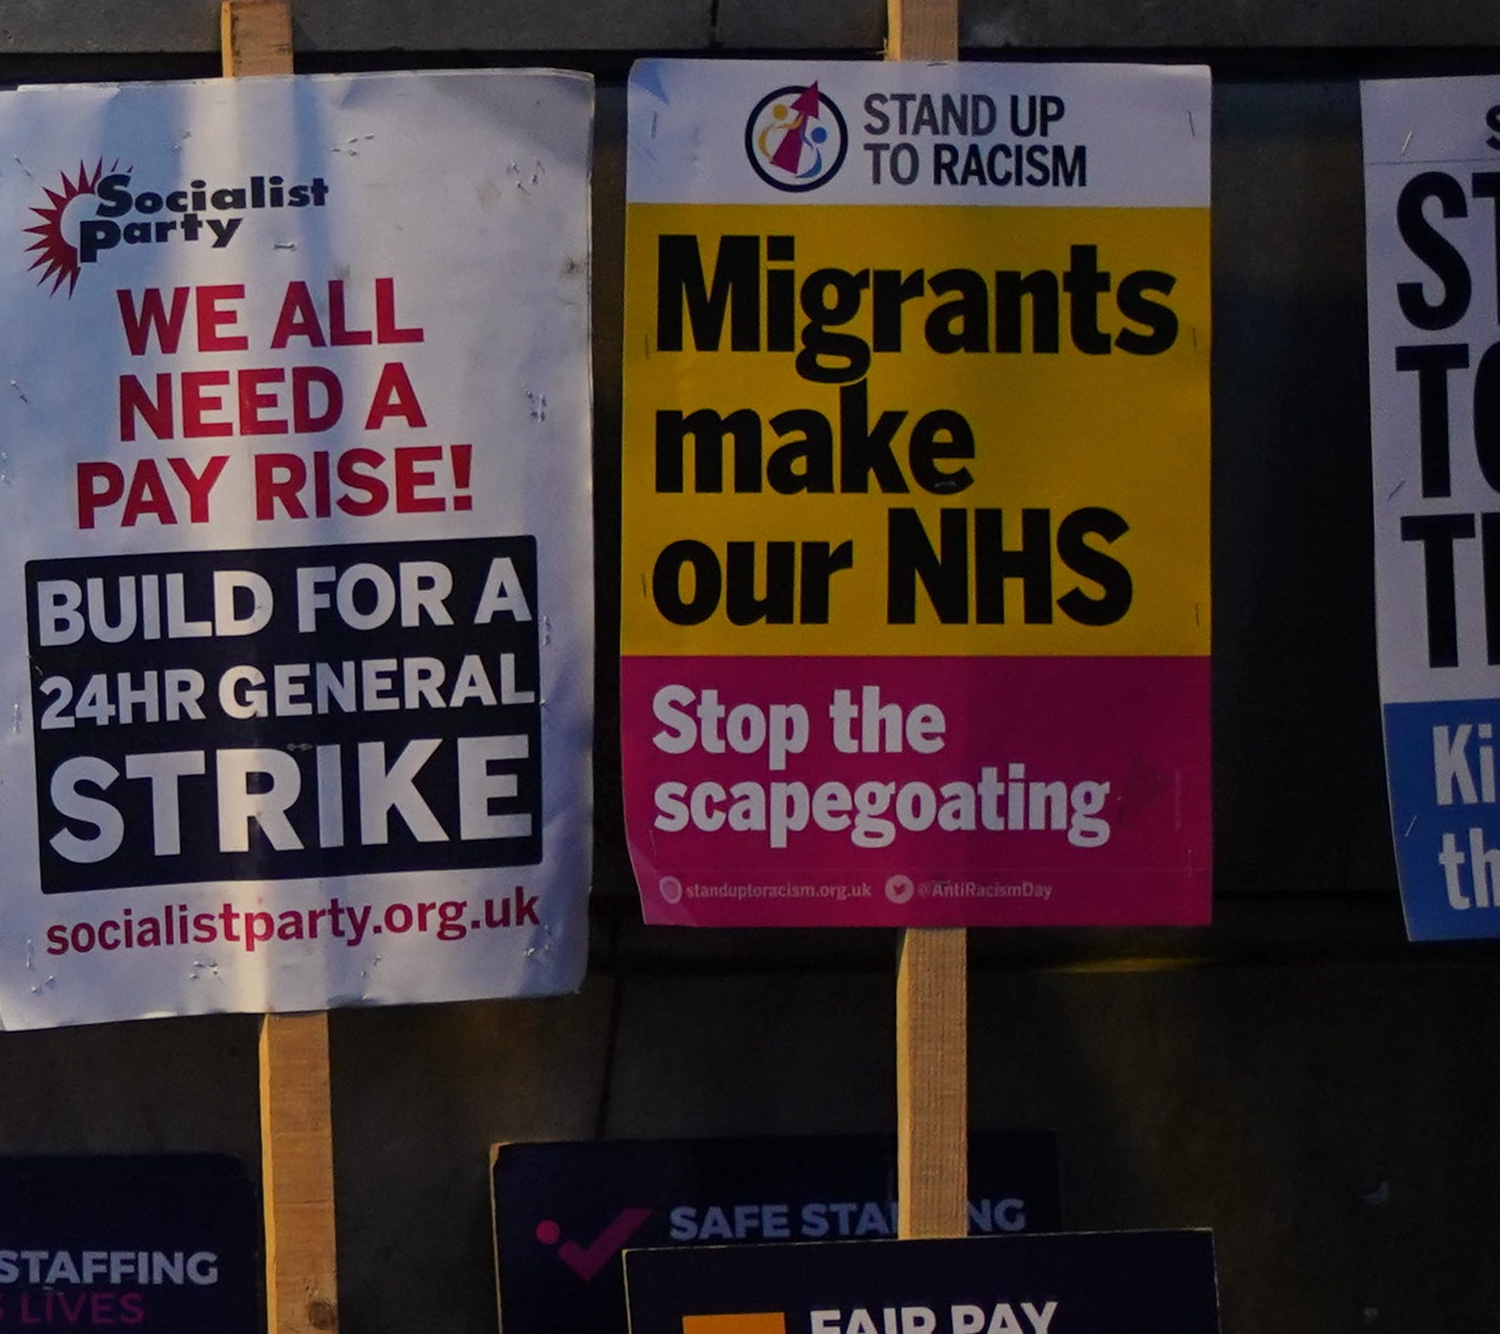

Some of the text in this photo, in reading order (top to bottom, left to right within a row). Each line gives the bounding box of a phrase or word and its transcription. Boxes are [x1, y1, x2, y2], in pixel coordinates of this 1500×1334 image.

[863, 93, 1065, 137] STAND UP
[96, 173, 329, 218] Socialist
[864, 143, 1086, 187] TO RACISM
[116, 278, 424, 356] WE ALL
[656, 235, 1179, 383] Migrants
[119, 362, 427, 442] NEED A
[655, 379, 975, 495] make
[77, 444, 472, 529] PAY RISE!
[37, 557, 532, 647] BUILD FOR A
[652, 507, 1133, 627] our NHS
[39, 653, 535, 731] 24HR GENERAL
[652, 685, 946, 771] Stop the
[49, 734, 532, 864] STRIKE
[654, 763, 1110, 848] scapegoating
[46, 887, 540, 956] socialistparty.org.uk
[686, 881, 872, 901] standuptoracism.org.uk
[21, 1292, 145, 1325] LIVES
